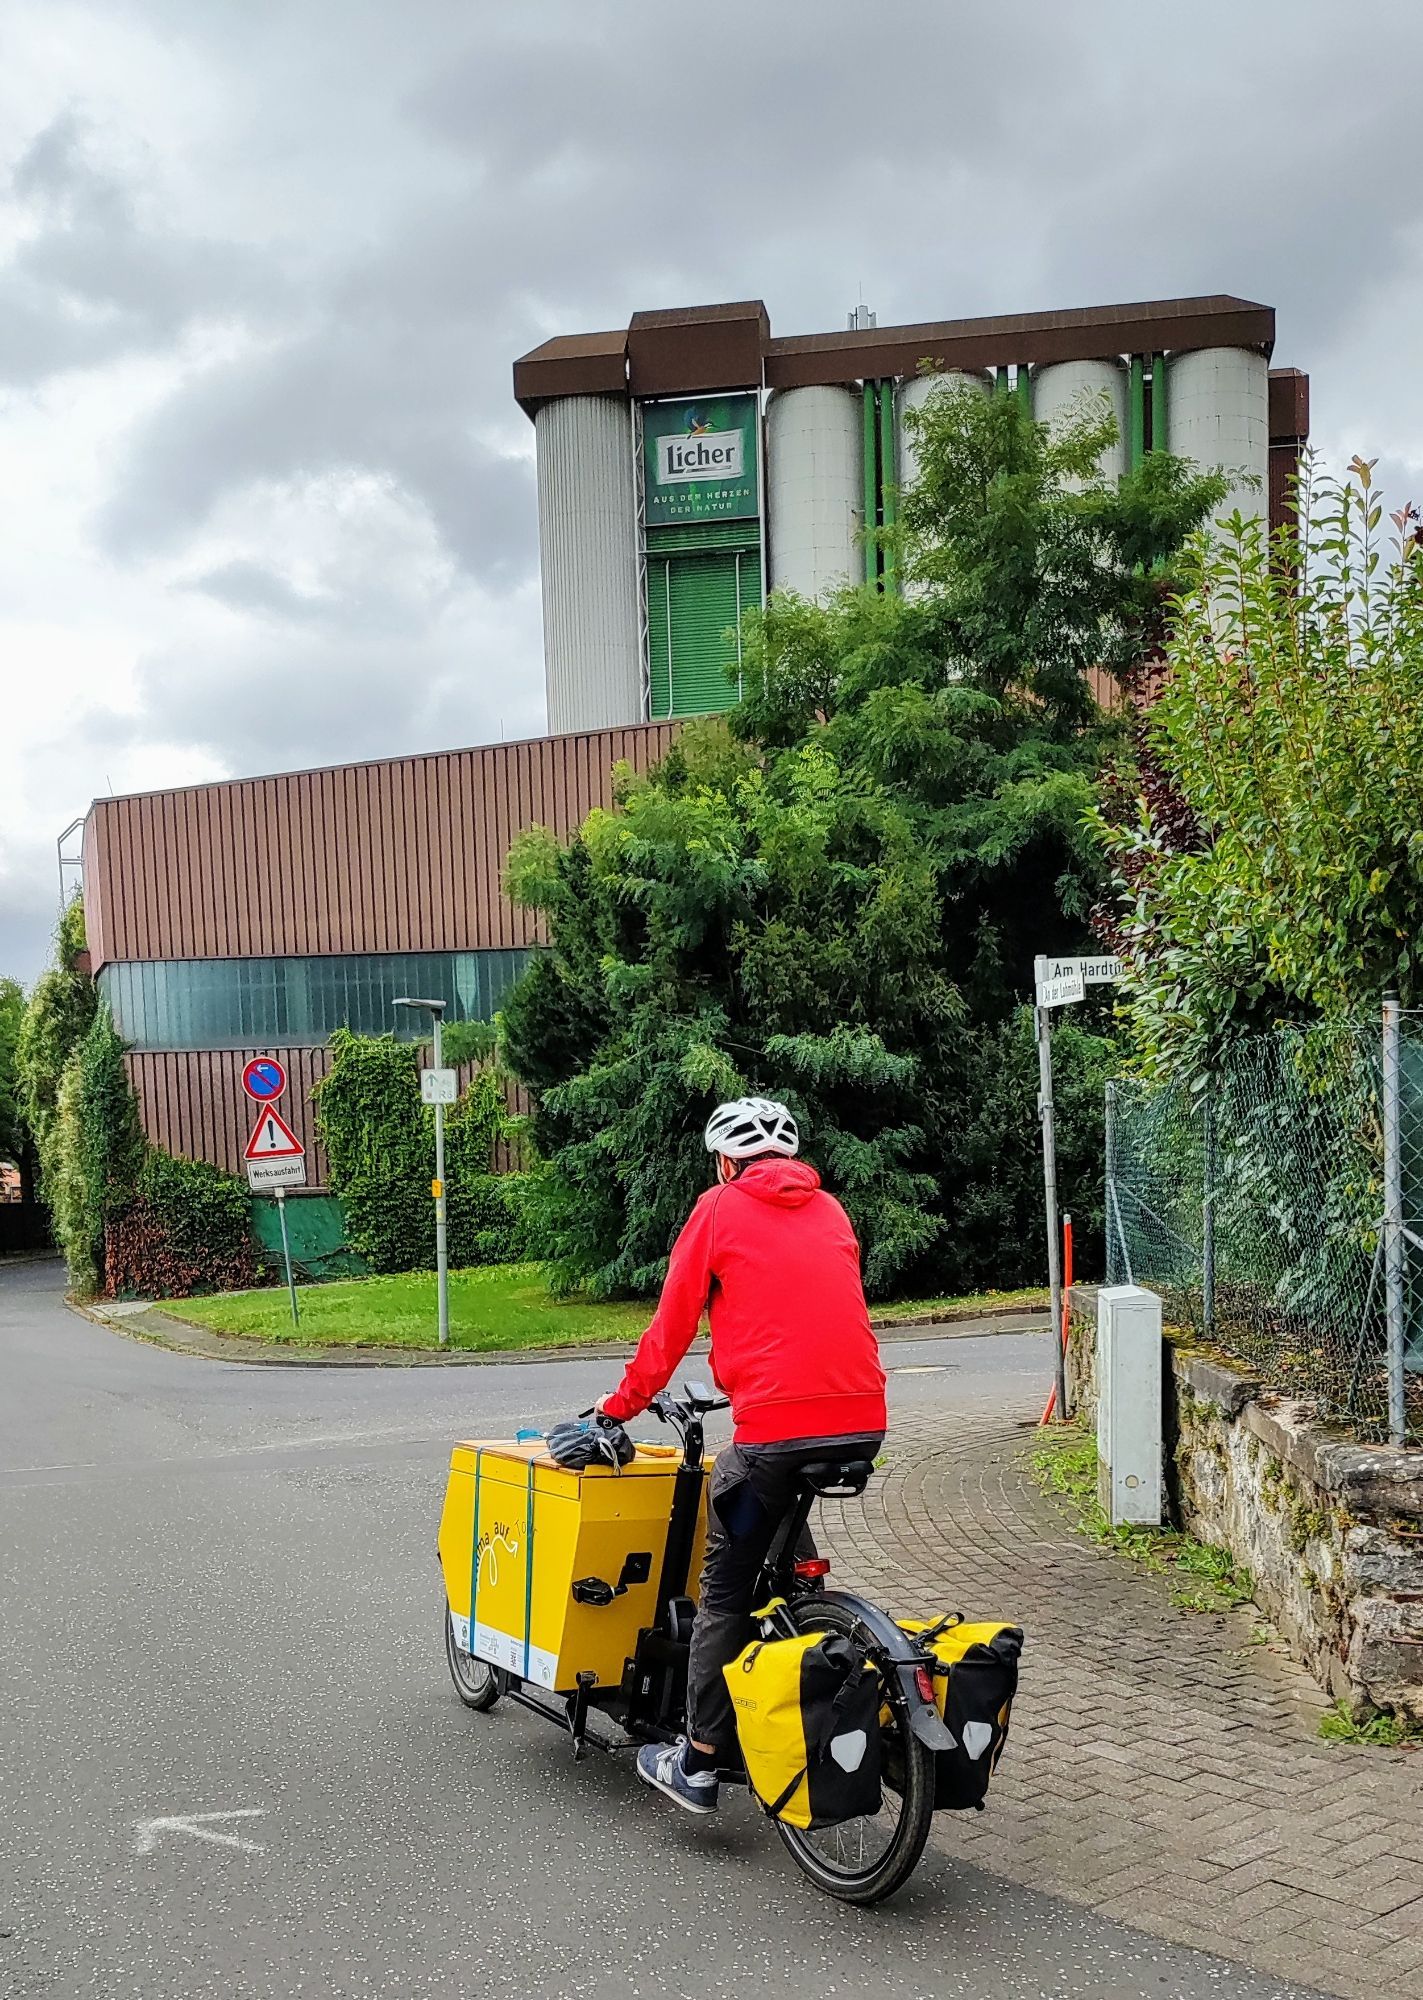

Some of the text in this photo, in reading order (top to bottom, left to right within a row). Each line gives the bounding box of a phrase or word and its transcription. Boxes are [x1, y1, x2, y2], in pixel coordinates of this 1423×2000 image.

[666, 442, 735, 474] Licher
[653, 489, 750, 504] AUS DEM HERZEN
[670, 502, 732, 514] DER NATUR
[1054, 962, 1073, 978] Am
[252, 1165, 301, 1179] Werksausfahrt
[494, 1521, 510, 1541] auf
[656, 1760, 673, 1785] N
